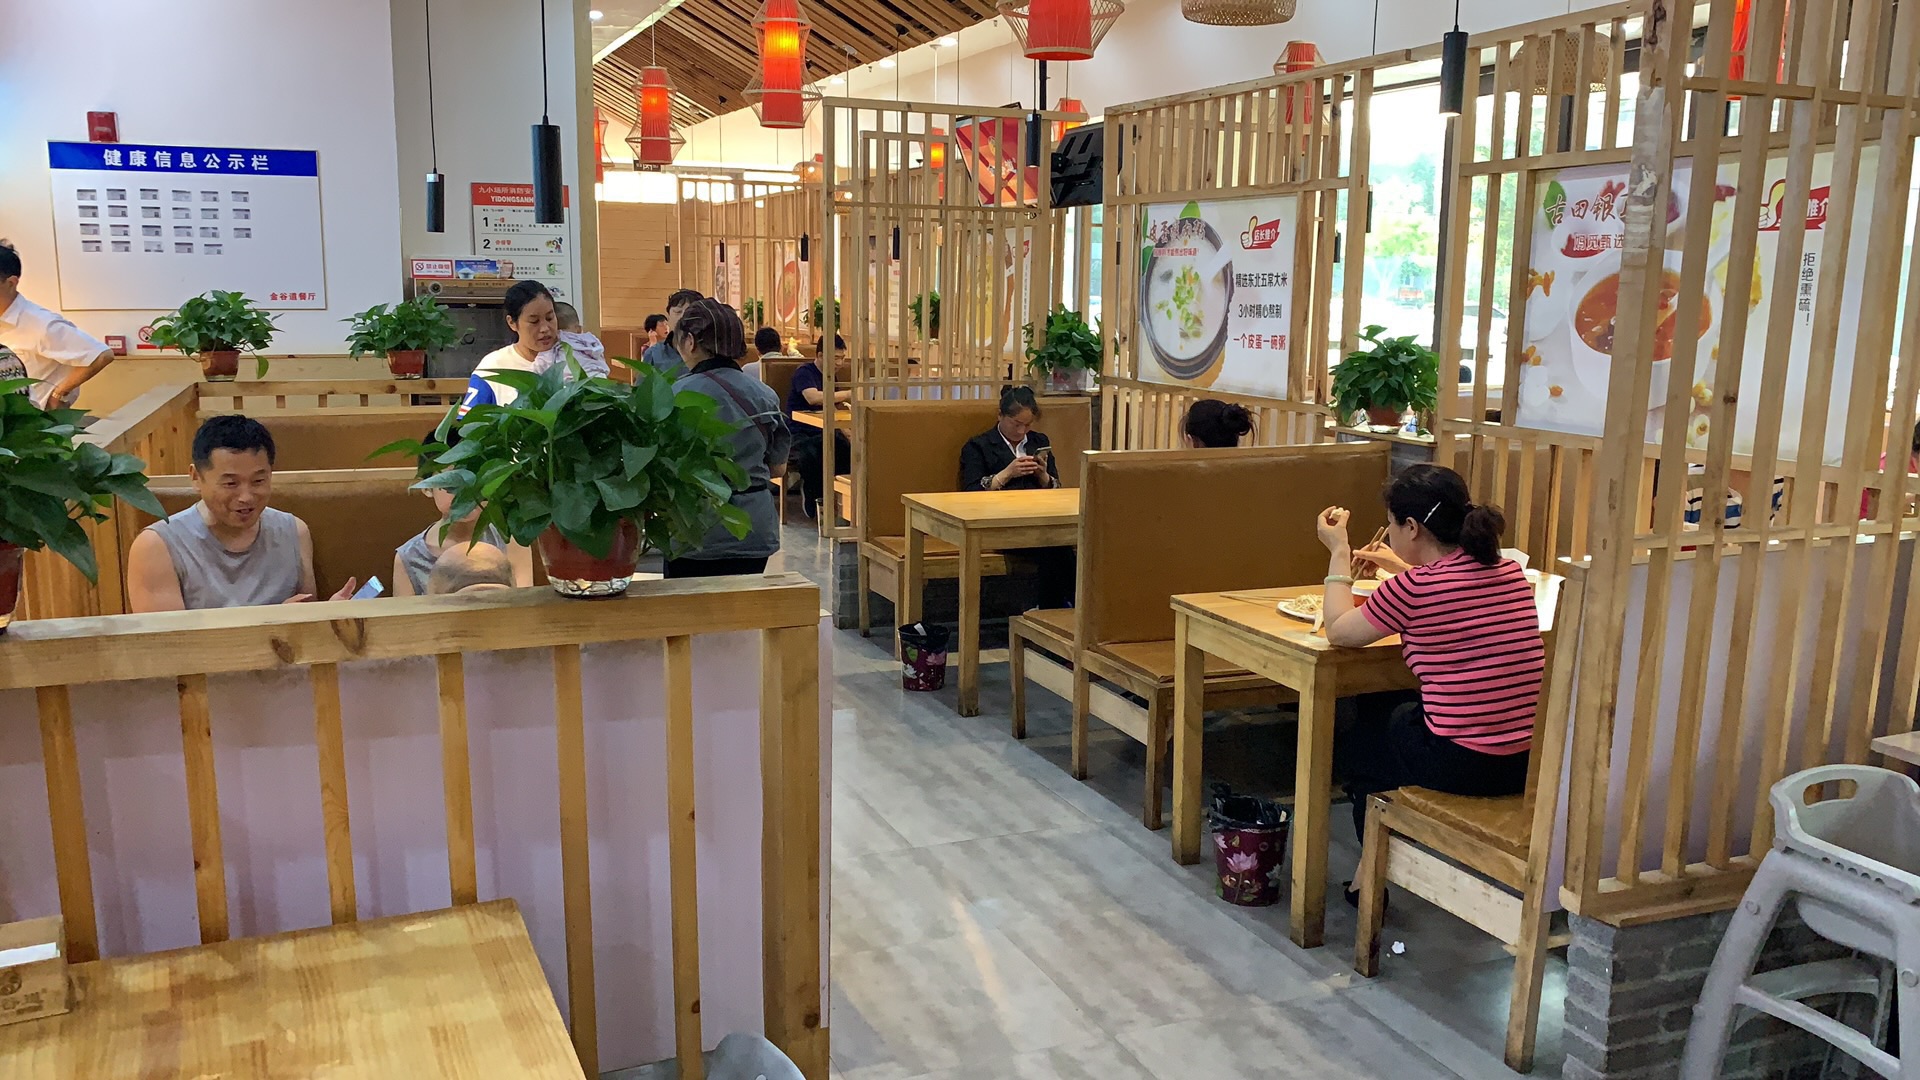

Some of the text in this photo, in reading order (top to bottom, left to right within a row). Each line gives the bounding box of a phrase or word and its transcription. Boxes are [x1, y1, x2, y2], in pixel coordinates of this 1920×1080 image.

[103, 149, 269, 171] 健康信息公示栏
[478, 186, 534, 194] 九小场所消防安
[483, 217, 488, 227] 1
[1254, 228, 1276, 241] 店长推介
[483, 239, 491, 249] 2
[1235, 272, 1288, 288] 精选东北五常大米
[1238, 303, 1282, 319] 3小时精心熬制
[1233, 333, 1286, 351] 一个皮蛋一碗粥
